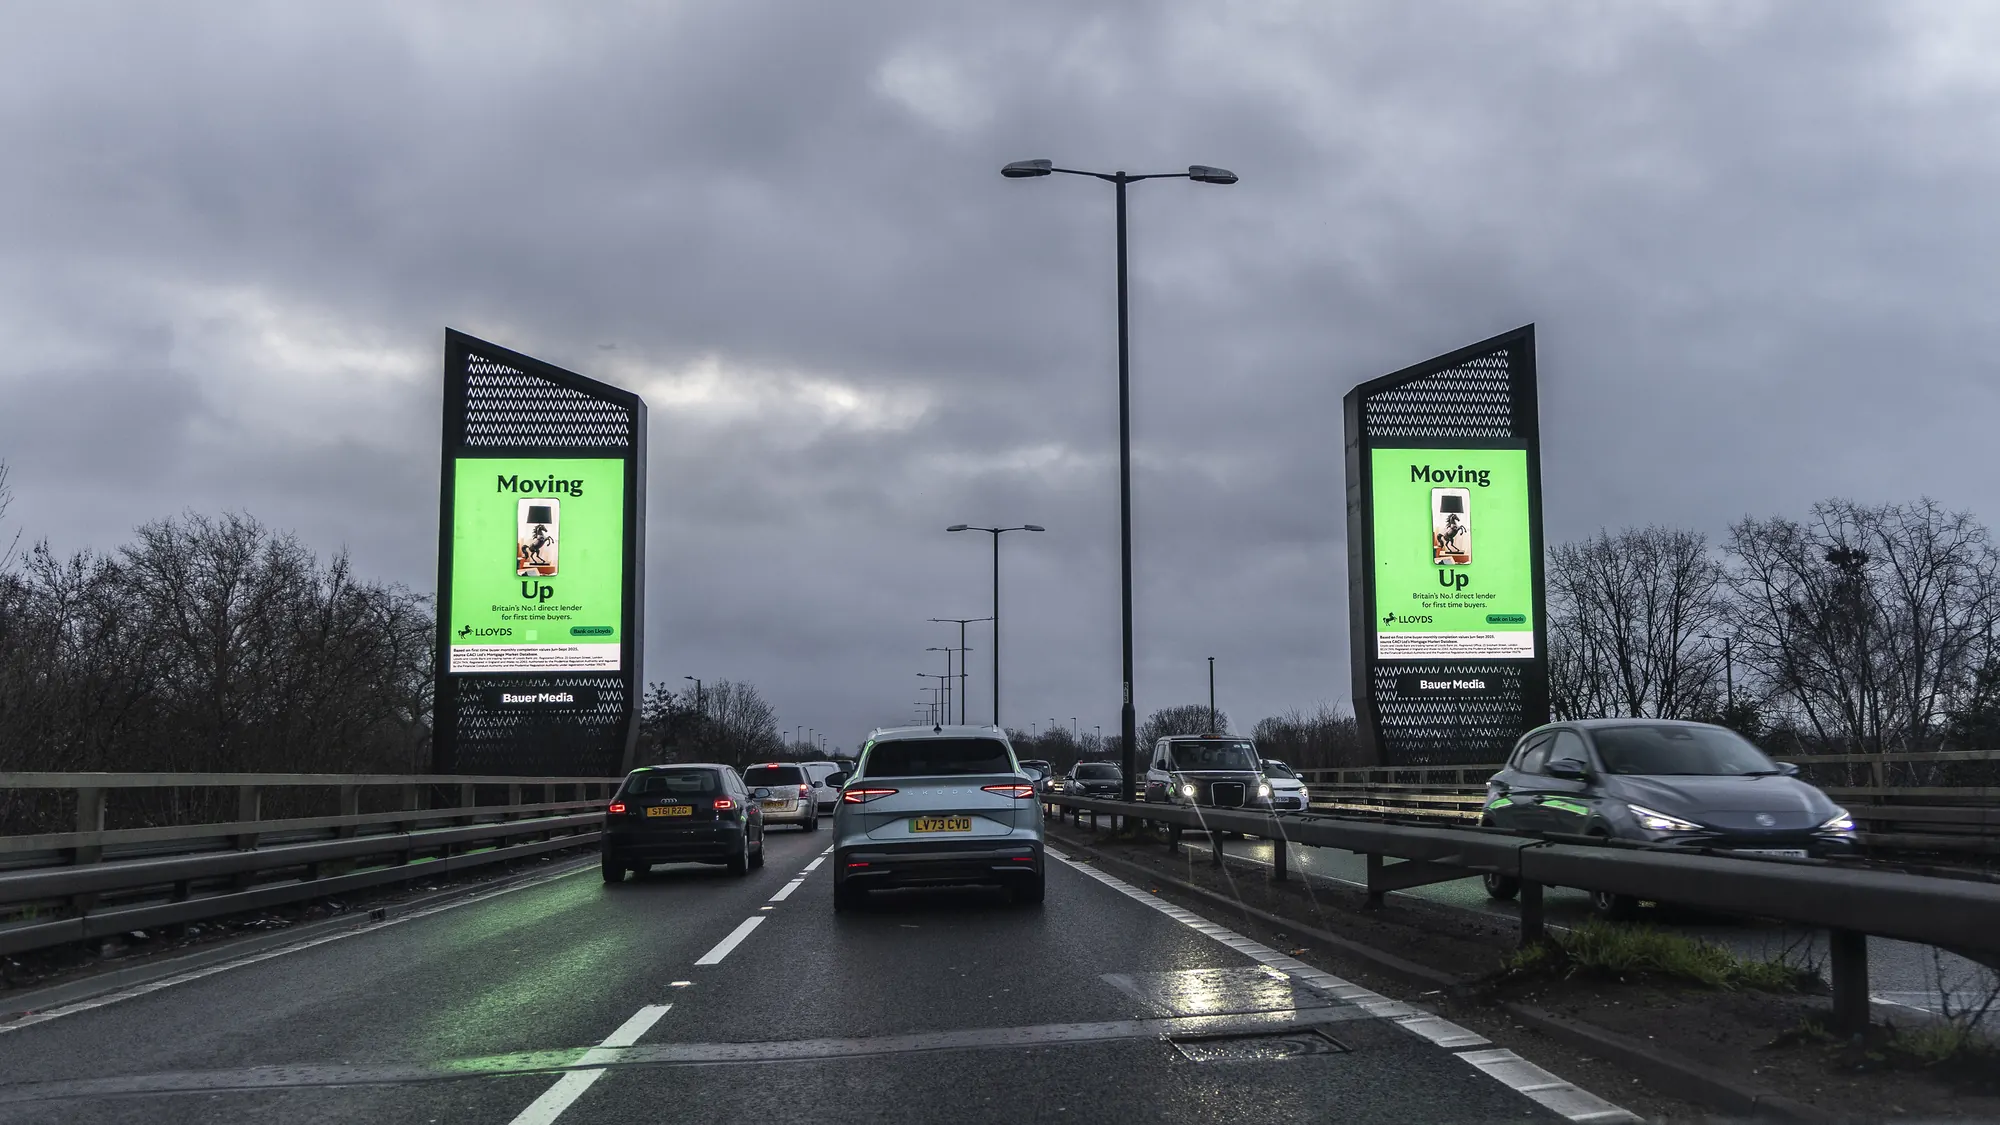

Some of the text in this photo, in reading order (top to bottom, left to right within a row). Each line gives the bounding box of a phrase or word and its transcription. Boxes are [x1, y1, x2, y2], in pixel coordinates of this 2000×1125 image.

[1411, 465, 1490, 487] Moving
[497, 475, 583, 497] Moving
[1439, 570, 1469, 591] Up
[521, 581, 554, 602] Up
[547, 613, 572, 621] buyers.
[1399, 616, 1432, 624] LLOYDS
[475, 628, 512, 636] LLOYDS
[1420, 680, 1485, 689] Bauer Media
[503, 693, 573, 703] Bauer Media
[916, 819, 969, 830] LV73 CVD
